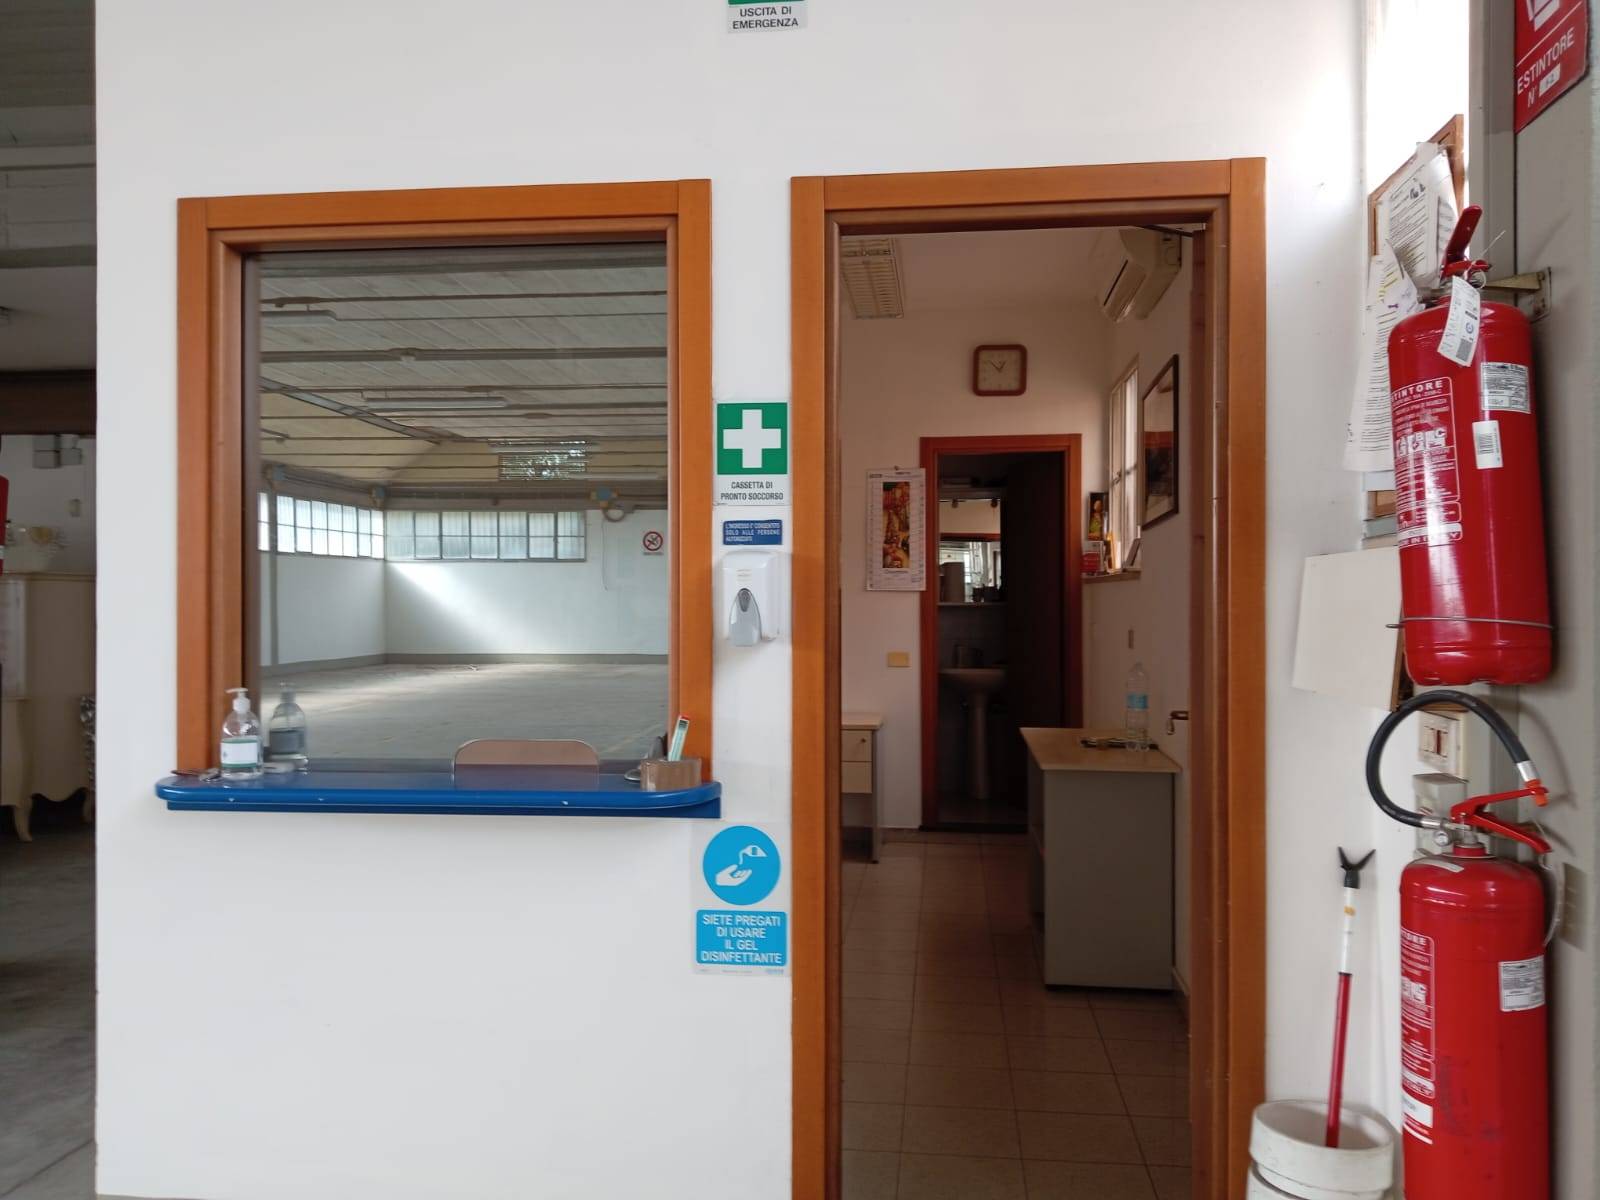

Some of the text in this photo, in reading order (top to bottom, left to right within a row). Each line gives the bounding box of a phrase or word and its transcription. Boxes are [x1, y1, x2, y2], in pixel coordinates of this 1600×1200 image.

[740, 6, 792, 17] USCITA DI
[732, 18, 799, 29] EMERGENZA
[1517, 26, 1575, 96] ESTINTORE
[731, 481, 773, 490] CASSETTA DI
[720, 492, 784, 501] PRONTO SOCCORSO
[703, 914, 781, 927] SIETE PREGATI
[716, 926, 767, 939] DI USARE
[724, 939, 759, 951] IL GEL
[701, 950, 783, 964] DISINFETTANTE
